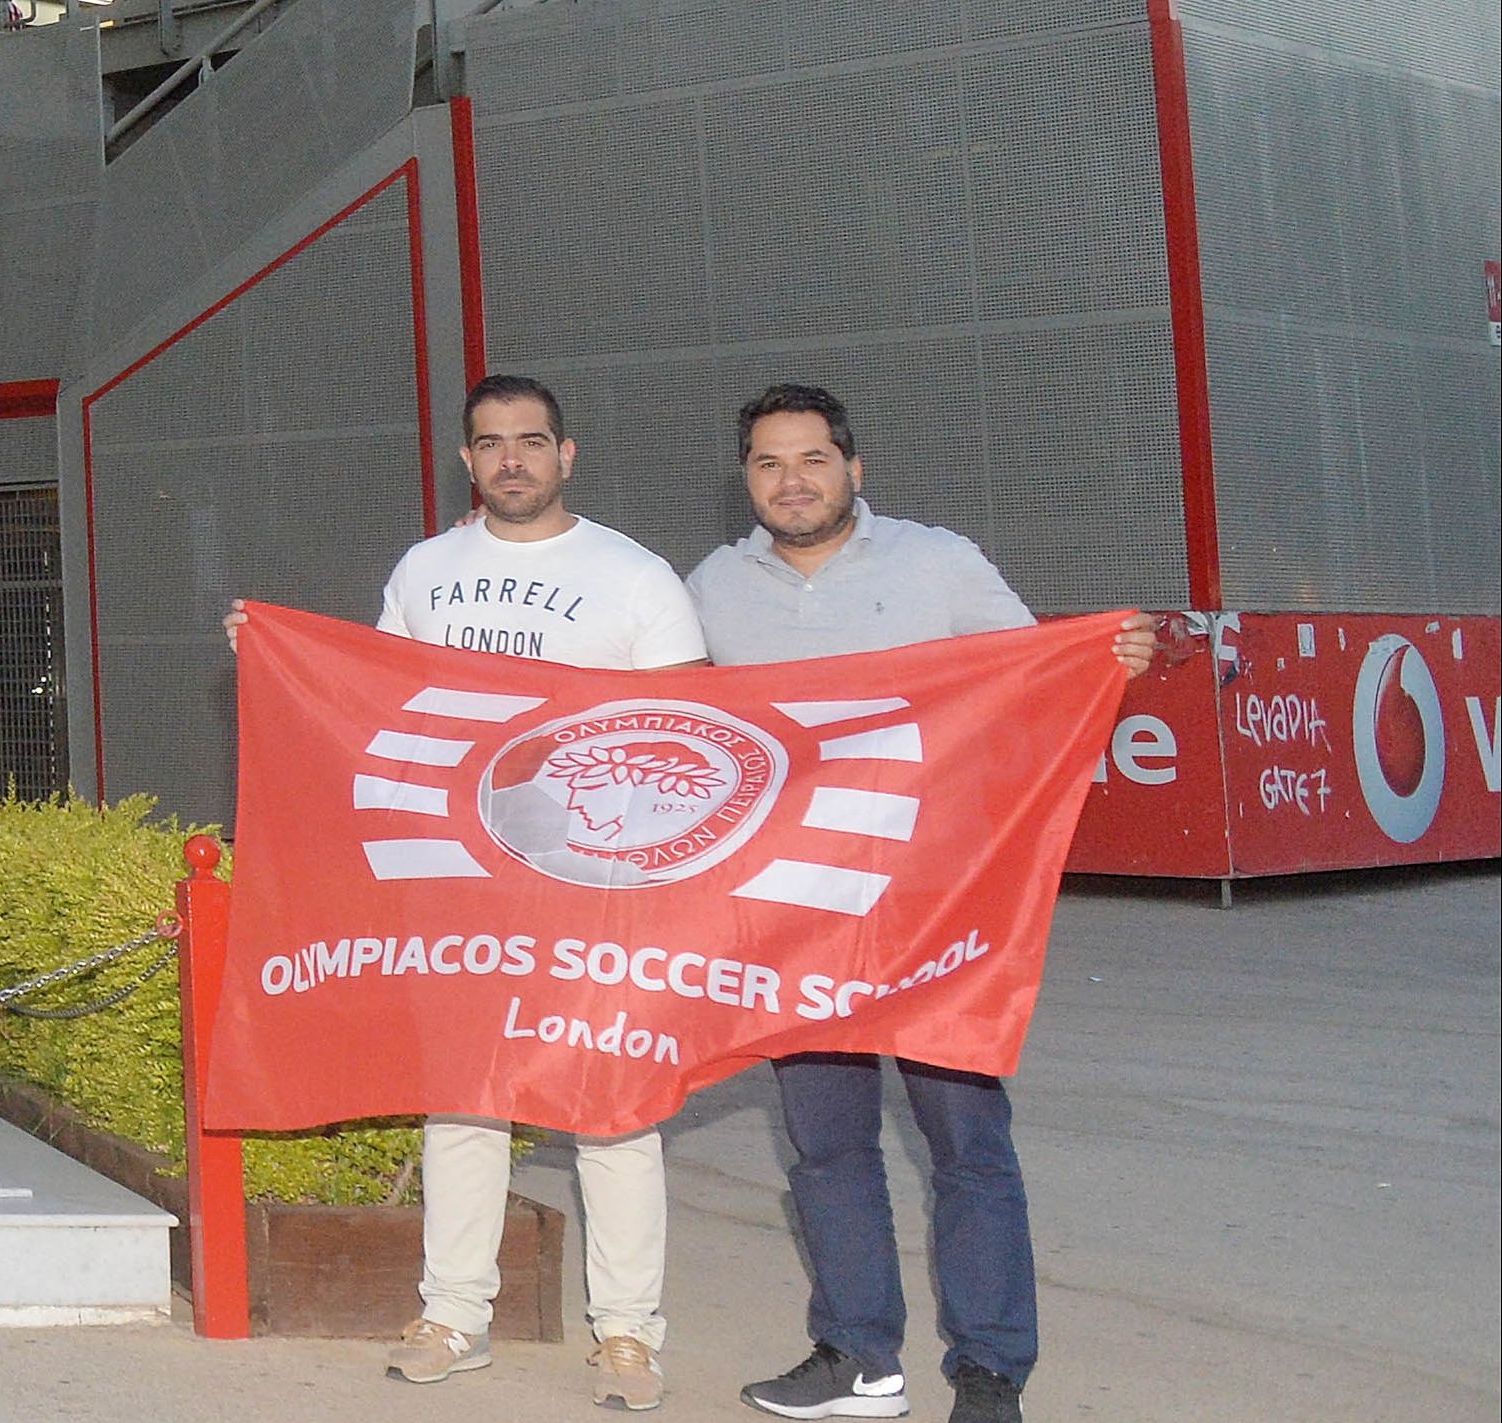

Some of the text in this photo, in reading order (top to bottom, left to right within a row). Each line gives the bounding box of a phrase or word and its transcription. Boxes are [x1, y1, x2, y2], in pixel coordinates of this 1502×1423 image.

[430, 578, 583, 622] FARRELL
[445, 624, 544, 657] LONDON
[554, 716, 745, 747] ΟΛΥΜΠΙΑΚΟΣ
[652, 802, 698, 814] 1925
[717, 748, 769, 824] ΠΕΙΡΑΙΩΣ
[261, 929, 990, 1021] OLYMPIACOS SOCCER SCOOL
[505, 996, 679, 1066] London
